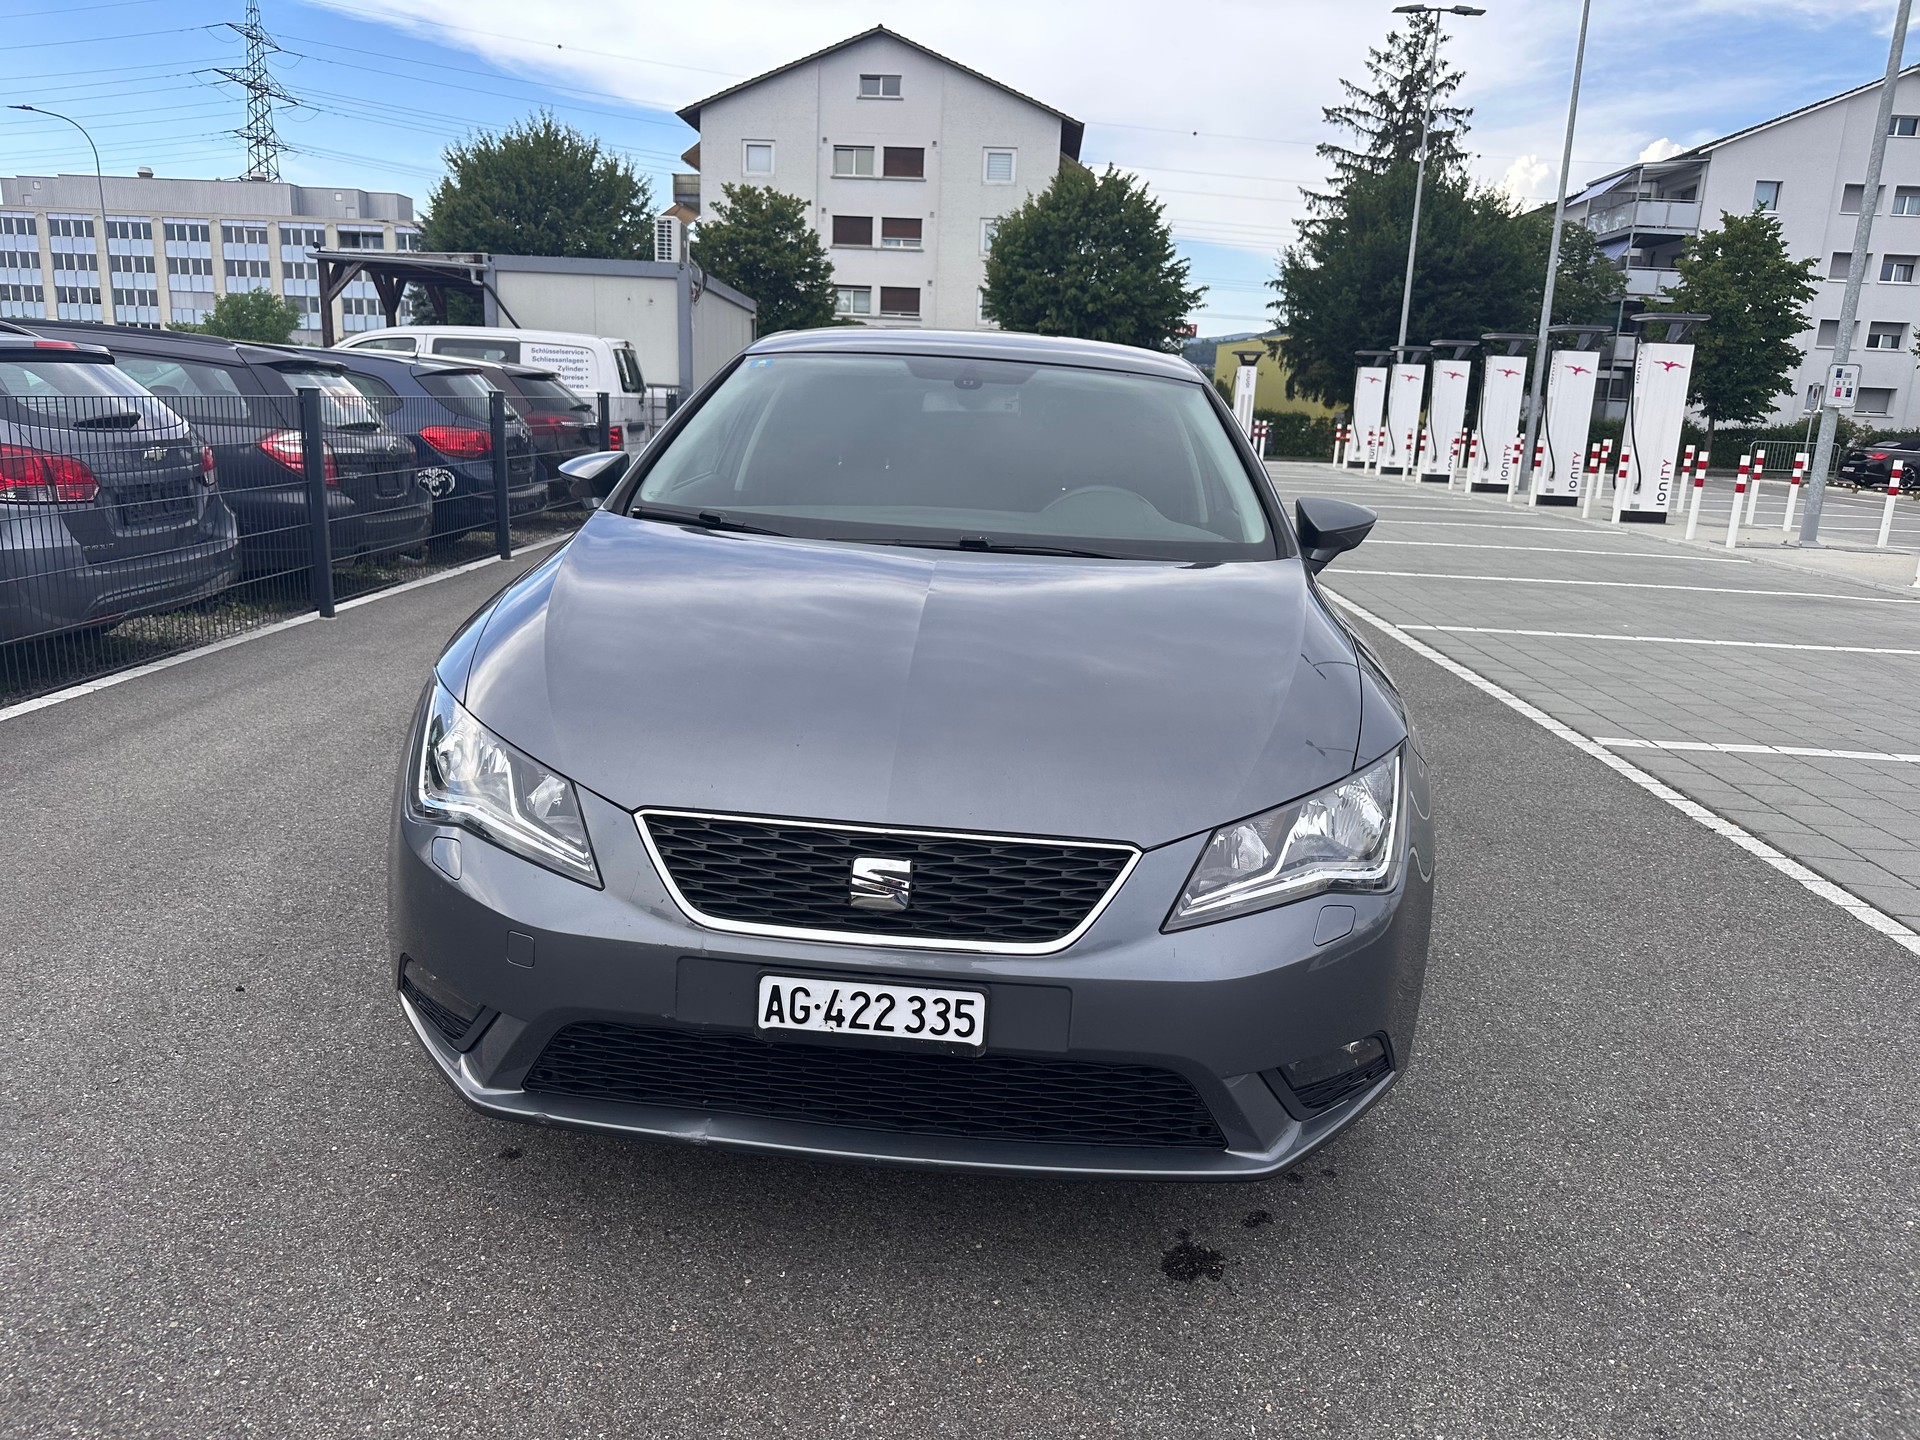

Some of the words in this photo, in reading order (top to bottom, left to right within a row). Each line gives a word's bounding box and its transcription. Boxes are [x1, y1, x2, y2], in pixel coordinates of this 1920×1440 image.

[532, 356, 584, 364] Schliessanlagen
[1568, 451, 1581, 492] IONITY
[1655, 458, 1672, 506] IONITY
